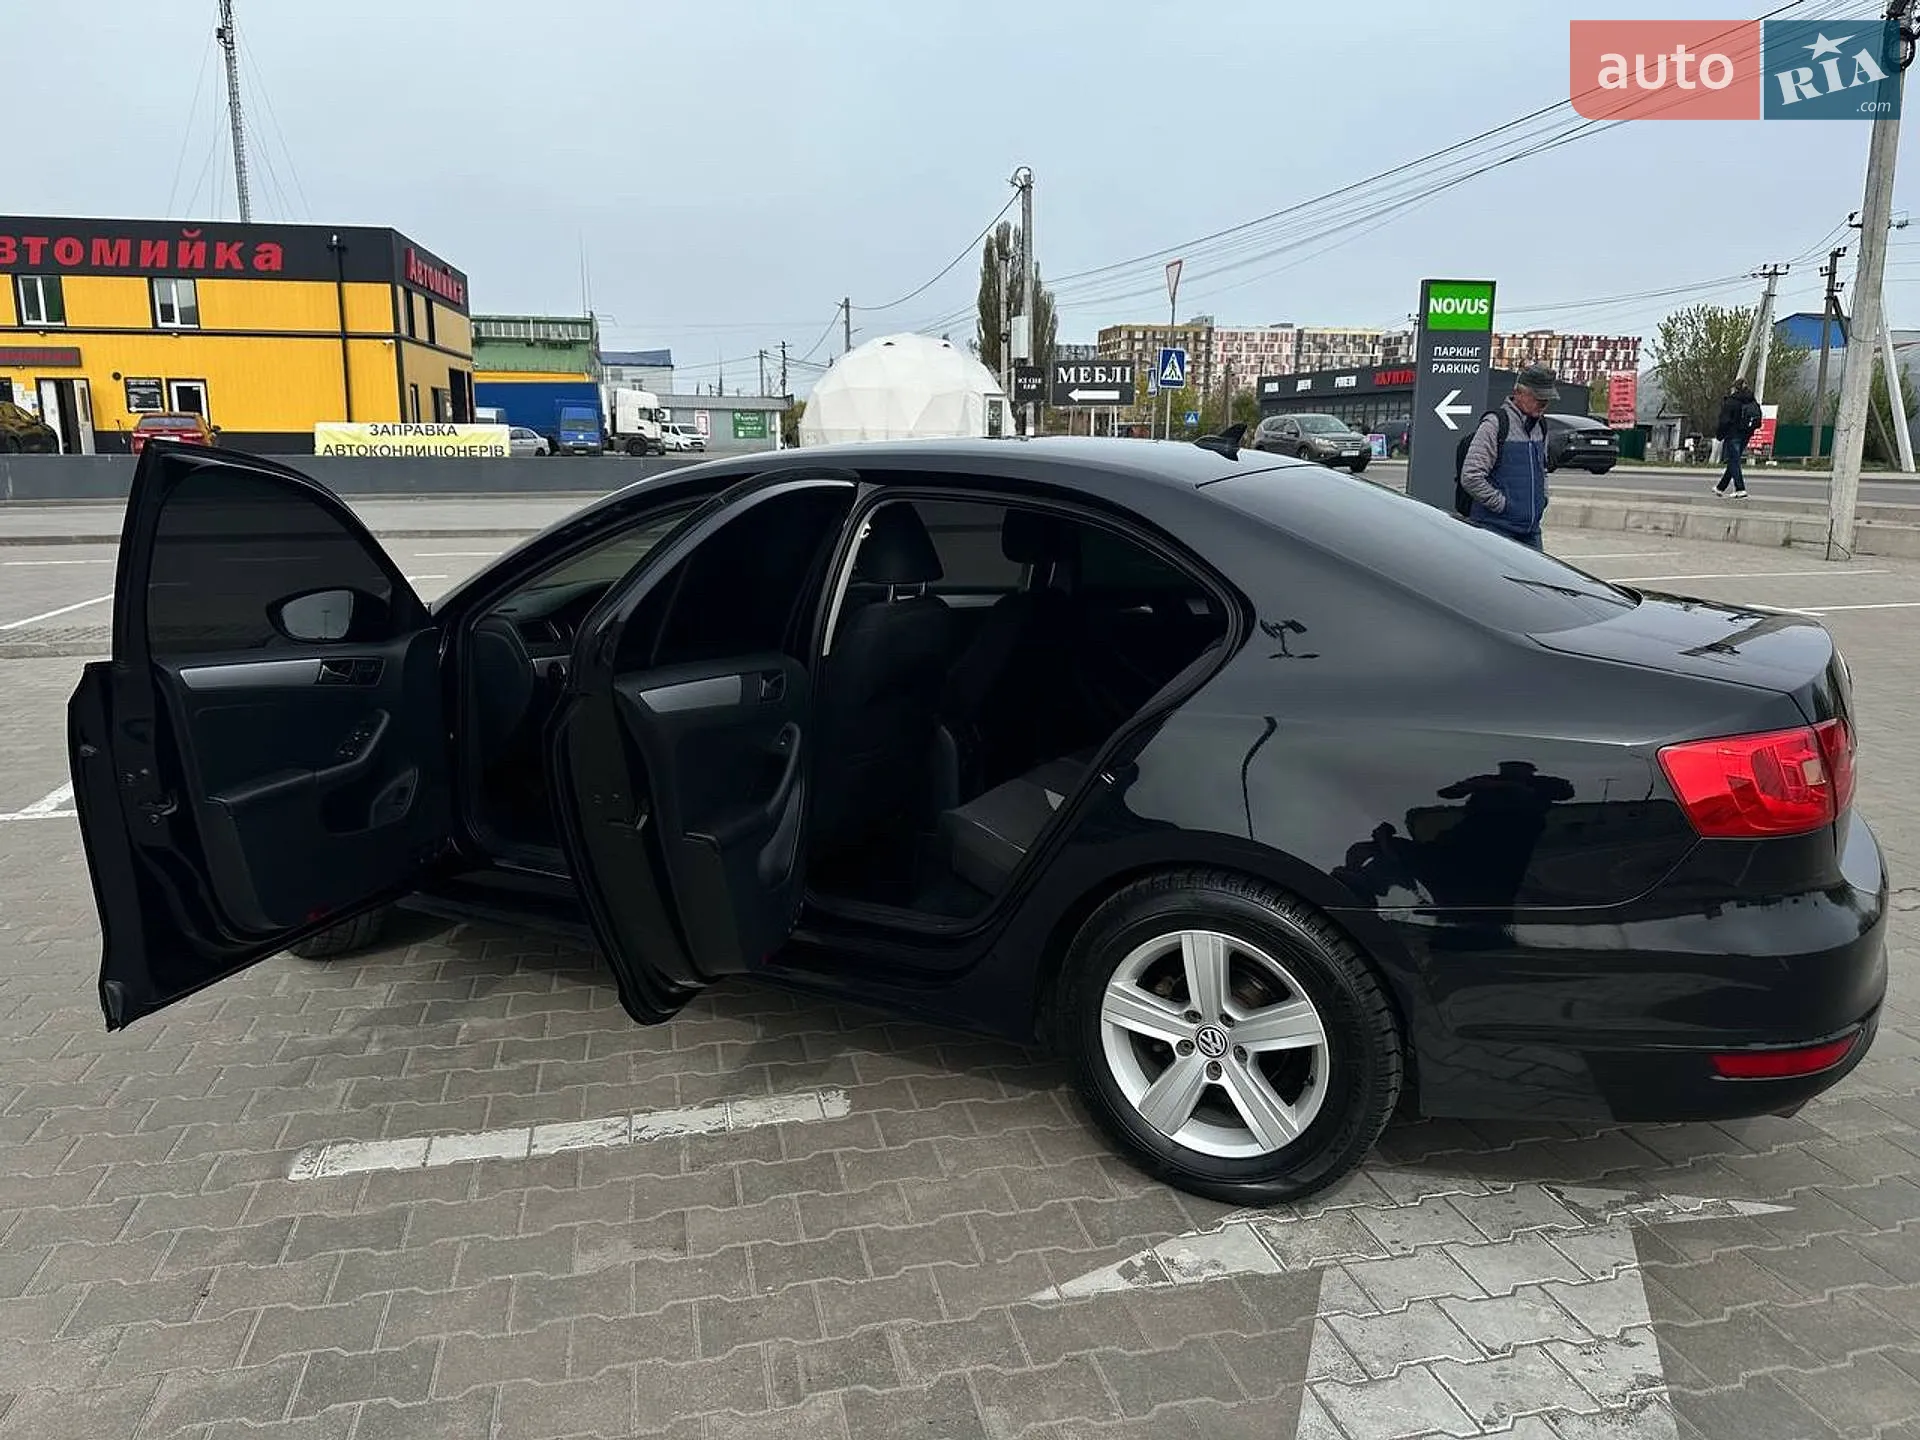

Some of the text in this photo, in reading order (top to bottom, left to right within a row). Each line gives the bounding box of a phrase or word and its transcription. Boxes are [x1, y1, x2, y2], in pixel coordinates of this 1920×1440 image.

[1429, 297, 1489, 315] NOVUS
[1433, 346, 1481, 357] ПАРКІНГ
[1057, 366, 1131, 384] МЕБЛІ
[1432, 363, 1480, 374] PARKING
[369, 424, 458, 437] ЗАПРАВКА
[323, 444, 505, 457] АВТОКОНДИЦІОНЕРІВ
